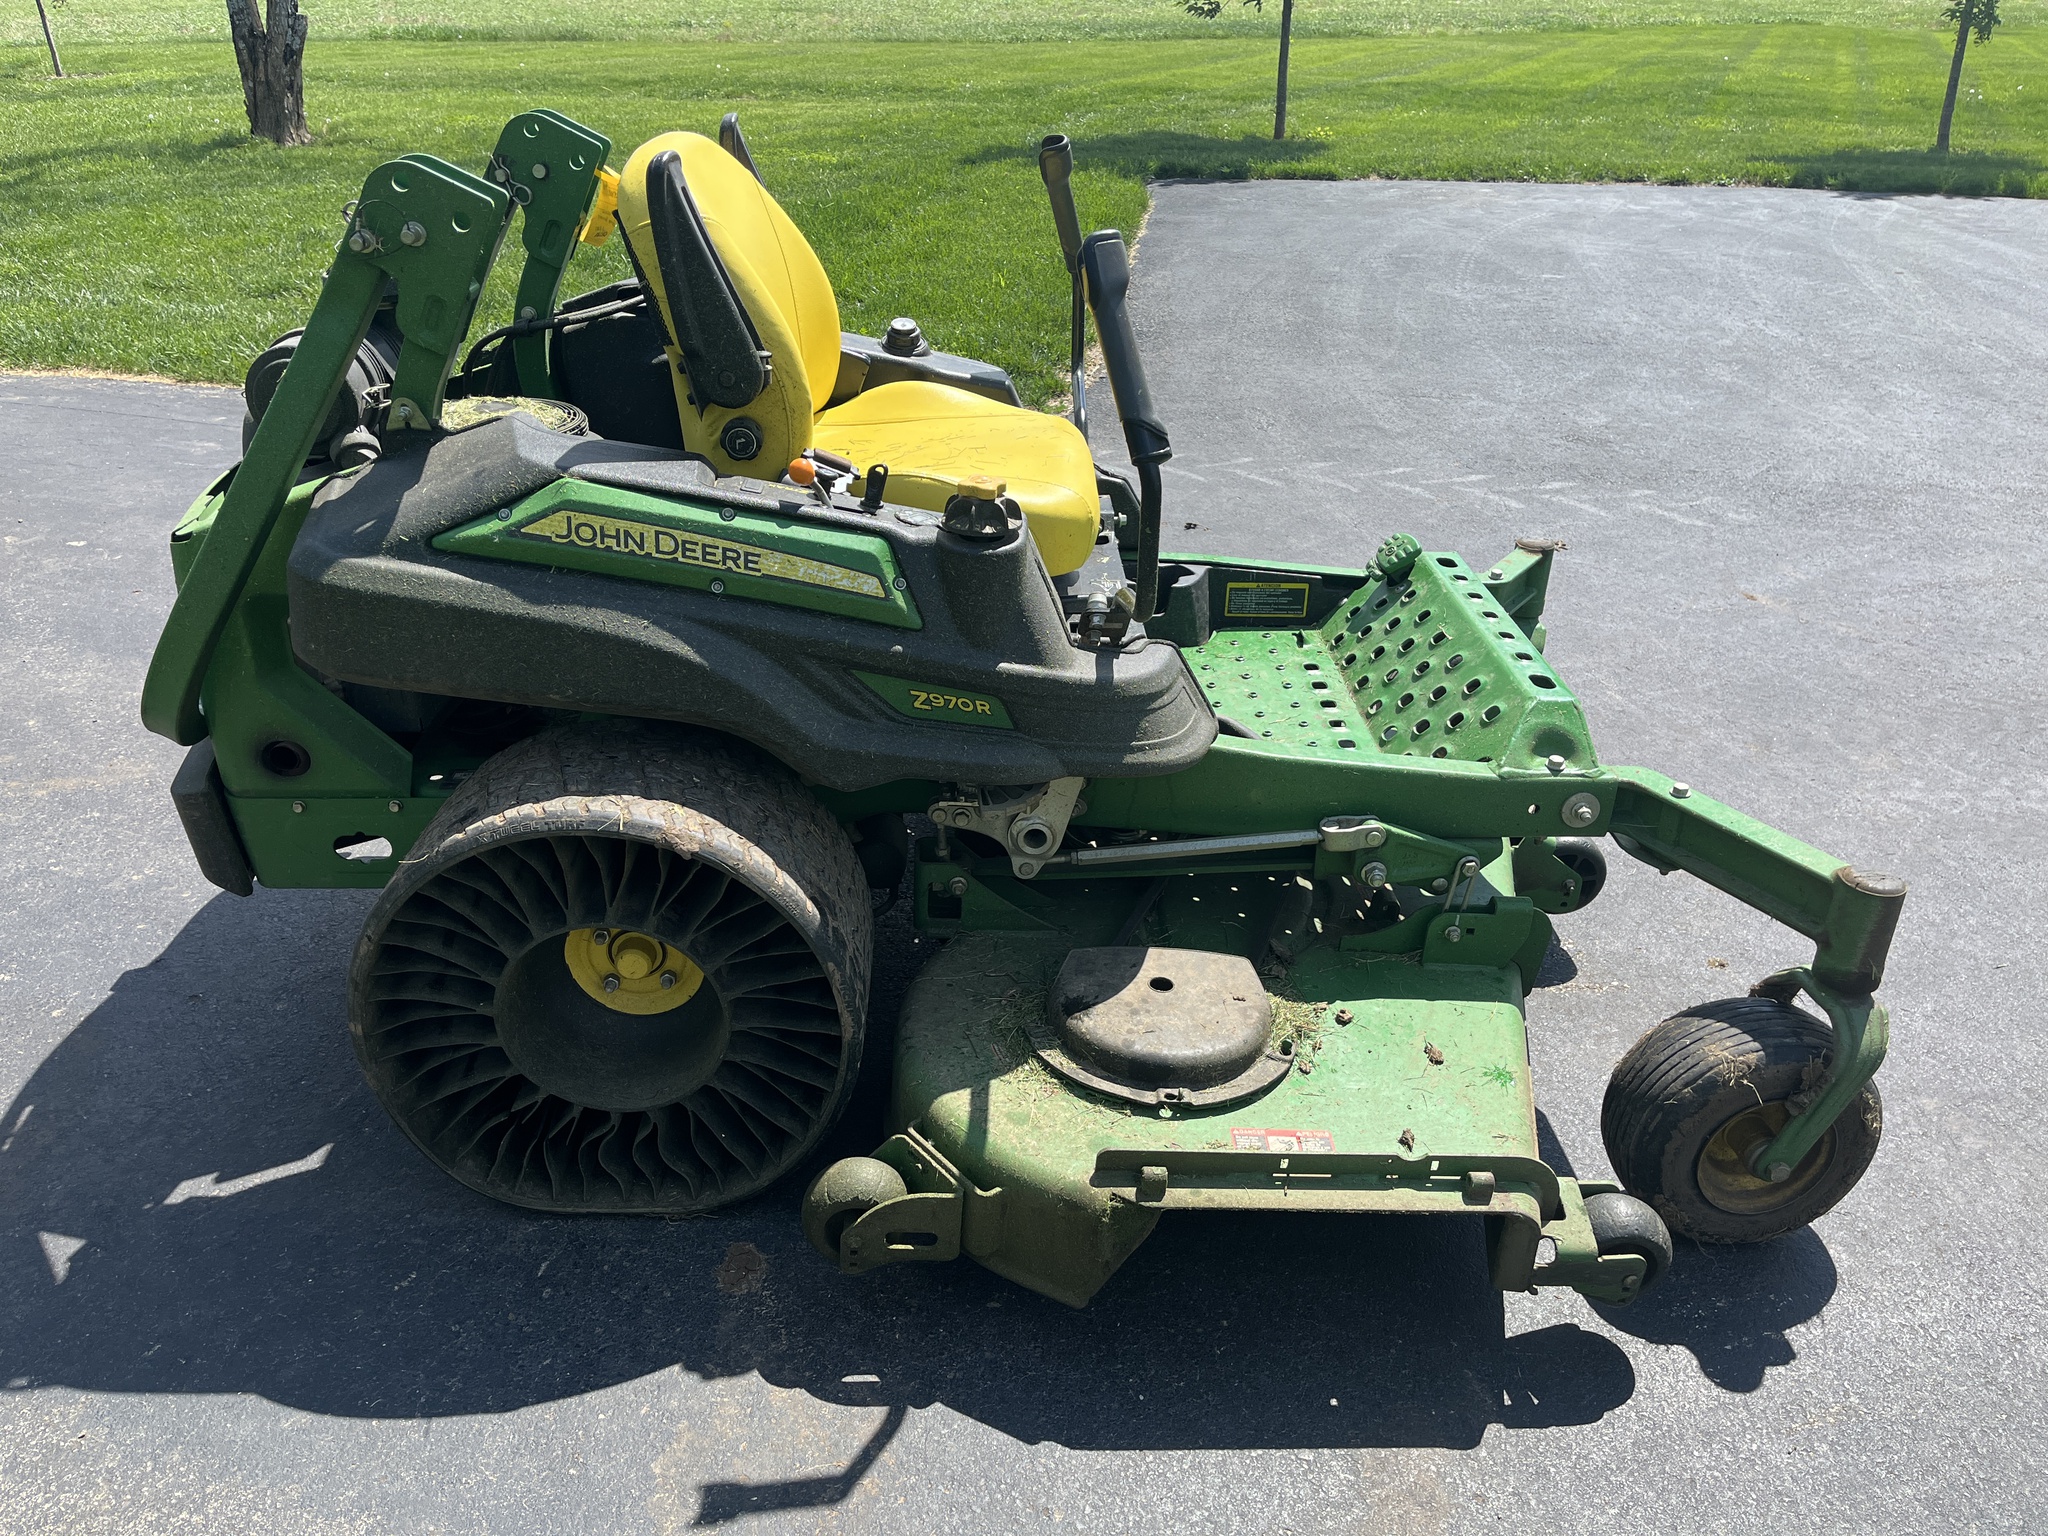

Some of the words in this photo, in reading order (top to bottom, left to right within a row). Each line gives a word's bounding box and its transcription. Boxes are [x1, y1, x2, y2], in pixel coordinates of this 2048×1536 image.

[555, 515, 645, 552] JOHN
[654, 531, 762, 573] DEERE
[909, 690, 992, 715] Z970R
